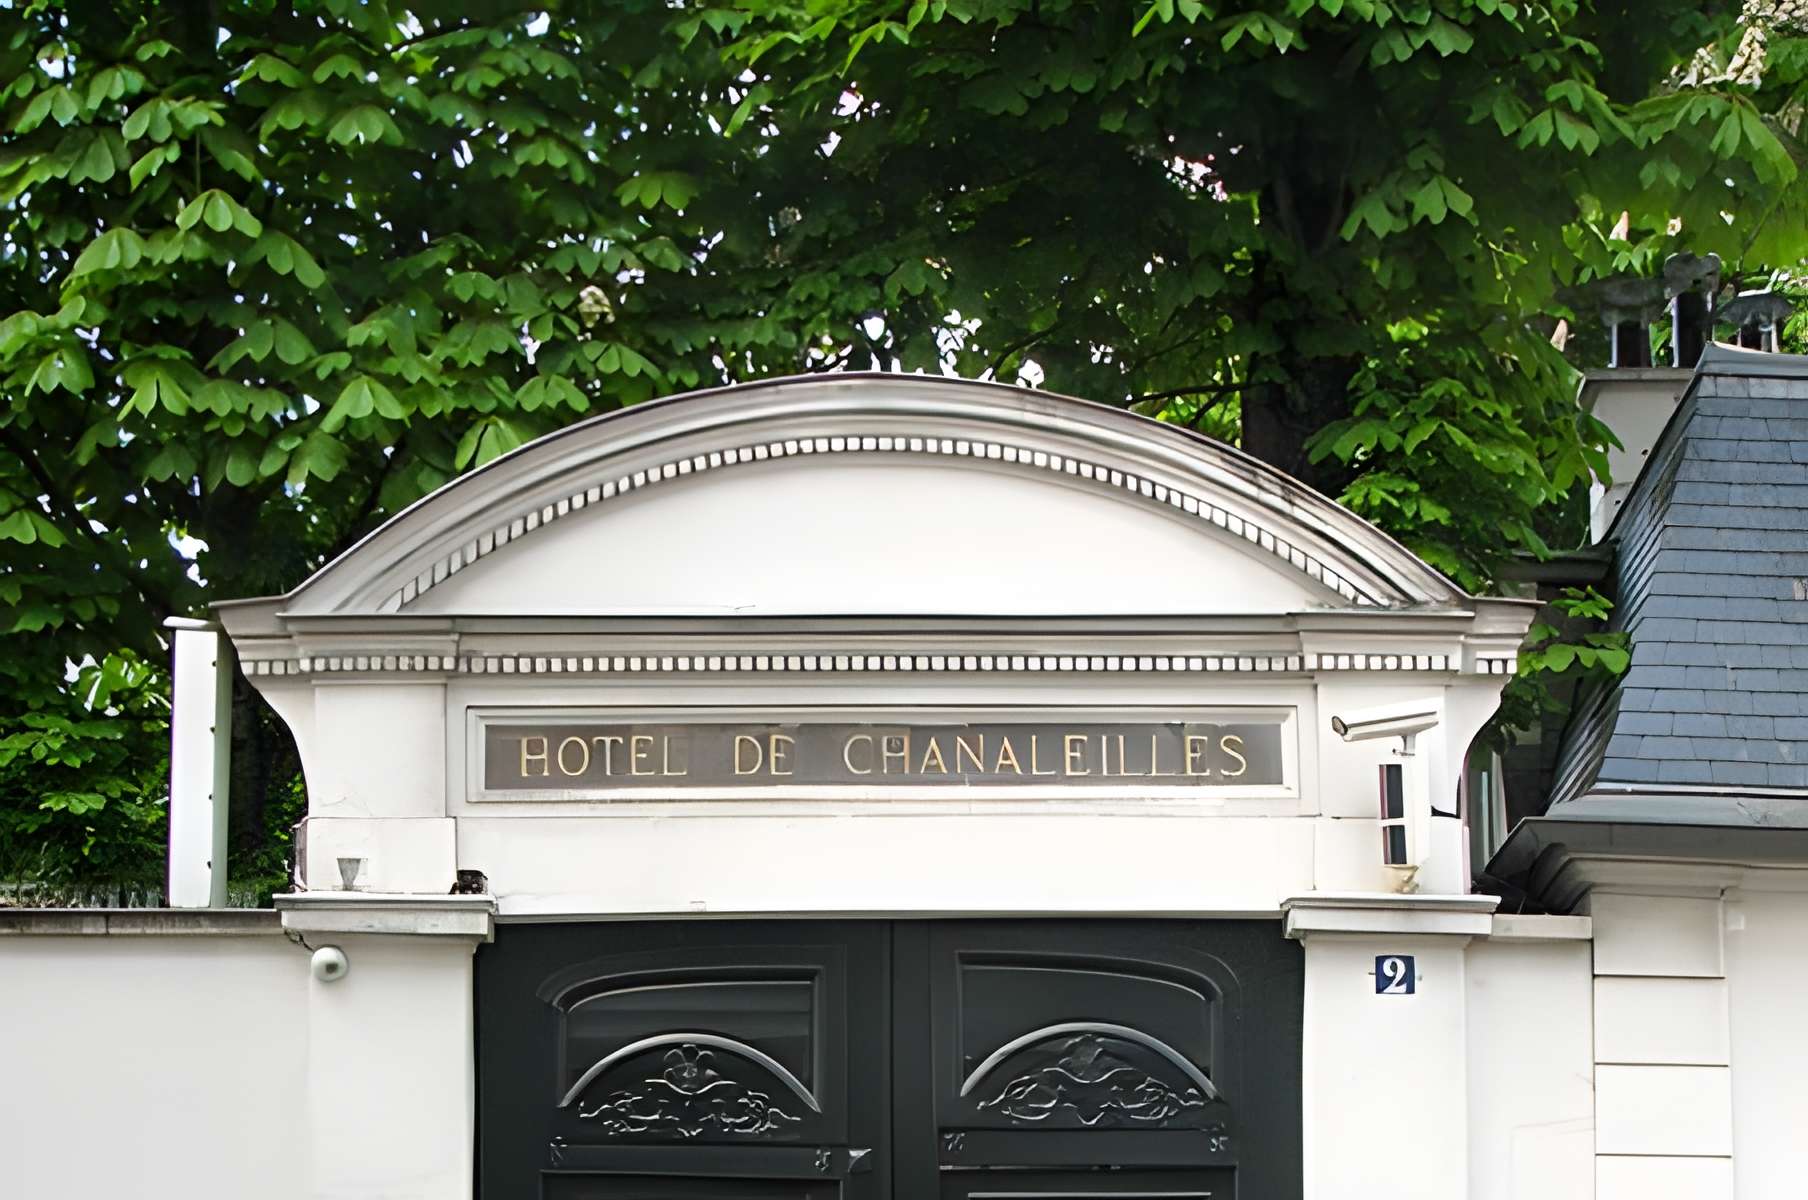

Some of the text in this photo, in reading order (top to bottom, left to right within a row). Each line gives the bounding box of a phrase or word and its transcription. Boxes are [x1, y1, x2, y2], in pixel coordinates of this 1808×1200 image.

[520, 733, 1248, 777] HOTEL DE CHANALEILLES
[1382, 957, 1408, 994] 2
